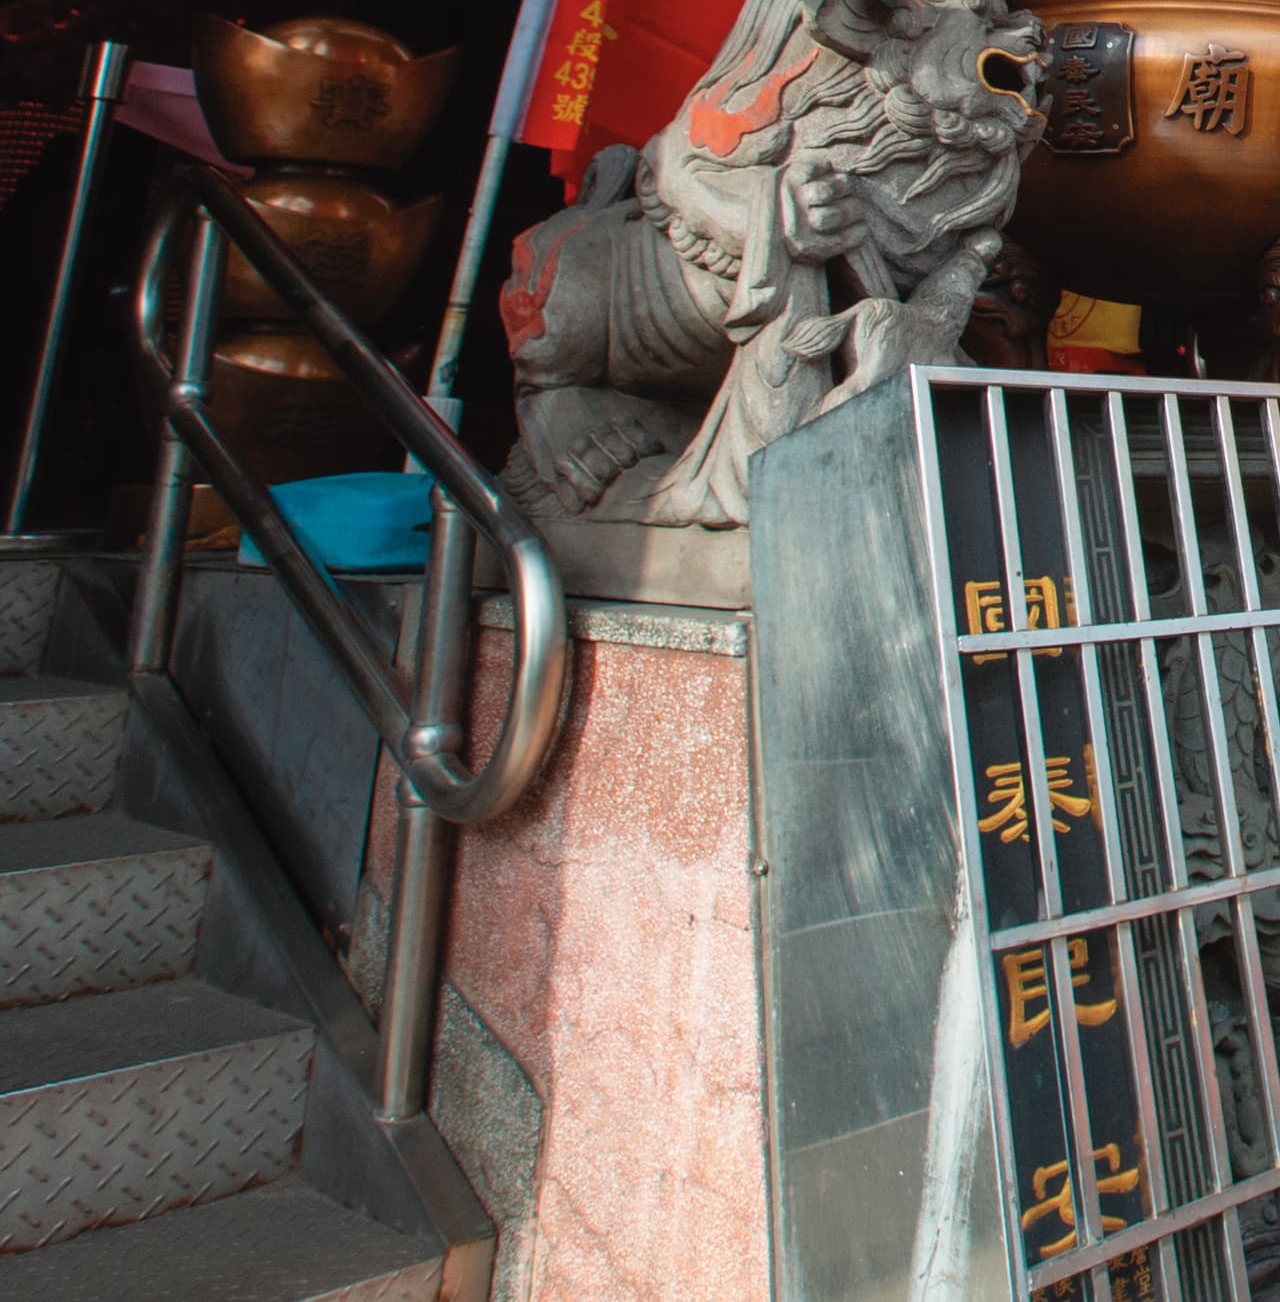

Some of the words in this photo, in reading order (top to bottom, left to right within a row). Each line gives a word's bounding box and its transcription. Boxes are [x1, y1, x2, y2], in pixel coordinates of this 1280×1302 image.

[1056, 24, 1106, 146] 國泰民安
[964, 578, 1140, 1258] 國泰民安
